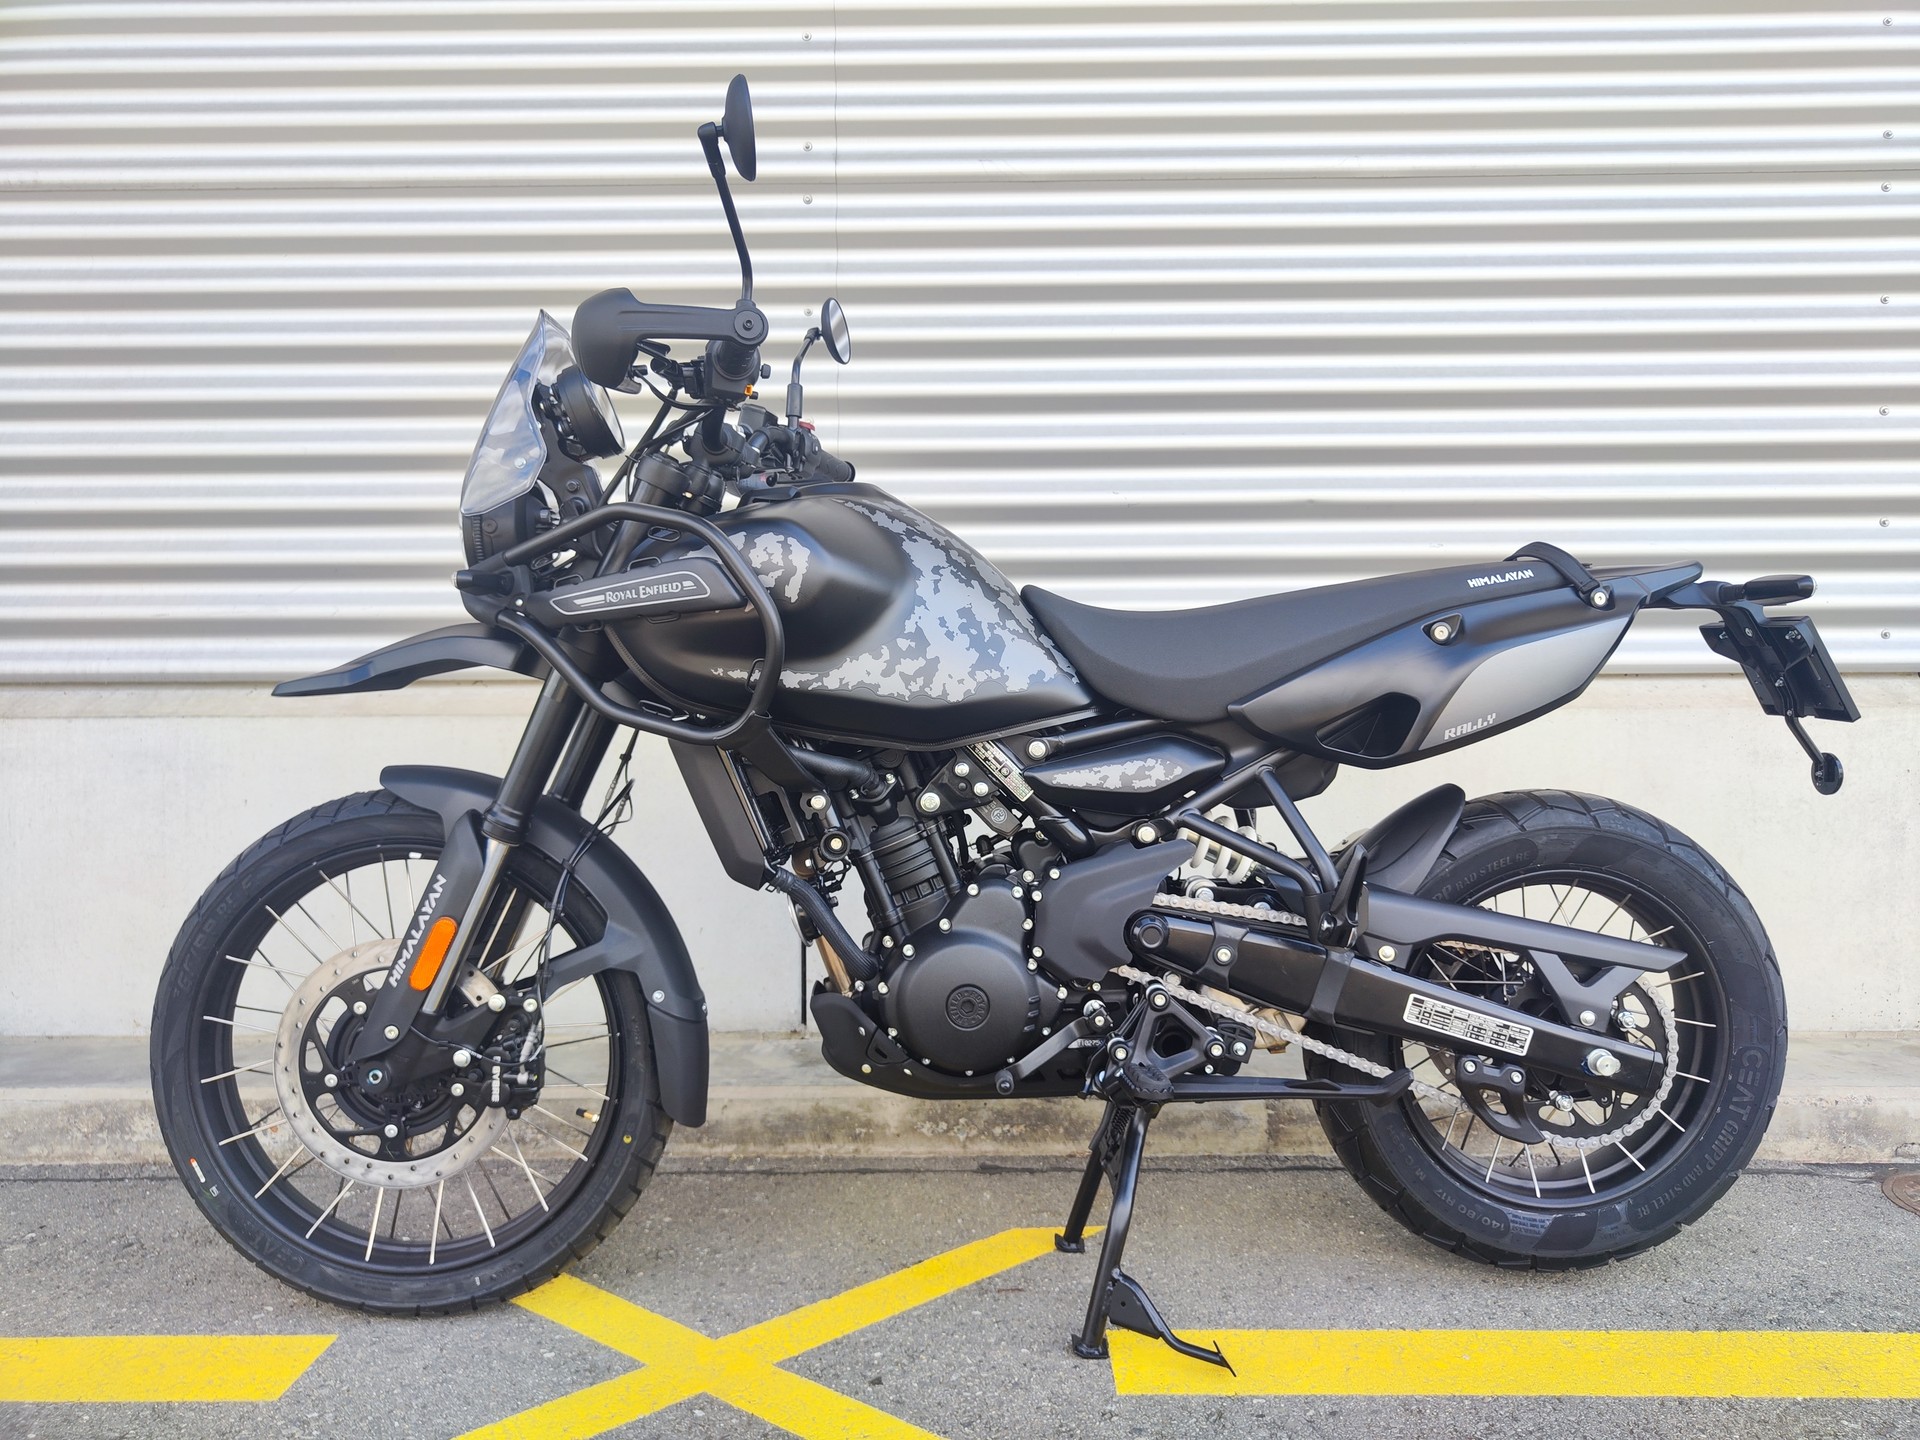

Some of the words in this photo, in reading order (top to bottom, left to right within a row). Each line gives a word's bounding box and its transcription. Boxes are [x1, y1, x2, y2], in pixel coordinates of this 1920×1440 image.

[1467, 570, 1534, 588] HIMALAYAN
[605, 590, 638, 604] ROYAL
[639, 582, 682, 599] ENFIELD
[1444, 713, 1497, 740] RALLY
[1479, 855, 1513, 877] STEEL
[389, 873, 447, 988] HIMALAYAN
[1728, 1048, 1763, 1120] CEAT
[1698, 1118, 1741, 1172] GRIPP
[1680, 1163, 1704, 1188] RAD
[1432, 1185, 1456, 1207] R17
[1650, 1182, 1683, 1211] STEEL
[1455, 1202, 1506, 1231] 140/80
